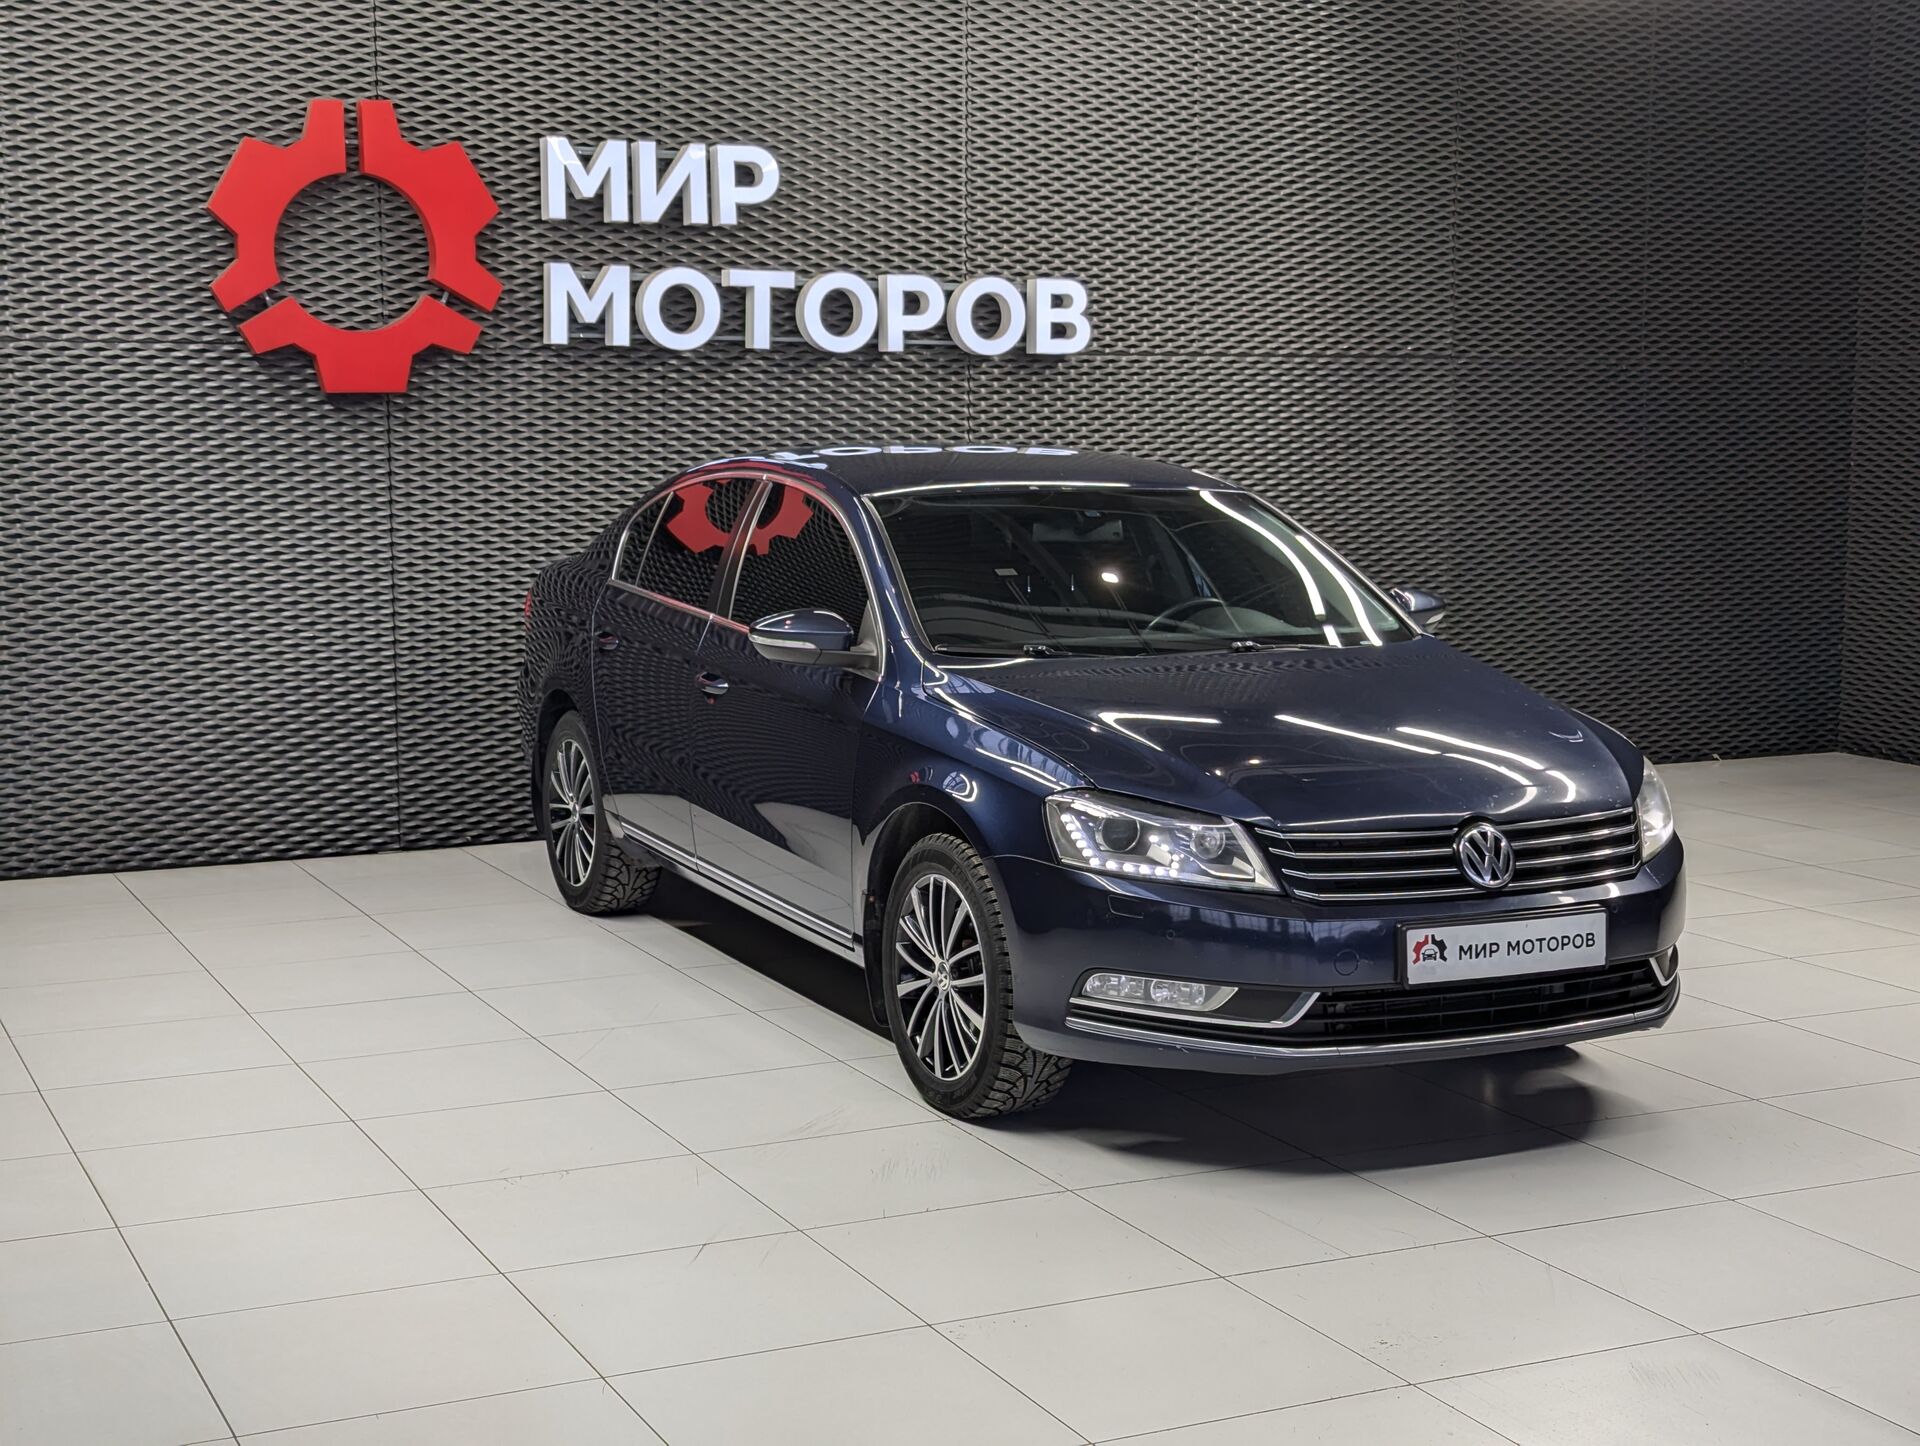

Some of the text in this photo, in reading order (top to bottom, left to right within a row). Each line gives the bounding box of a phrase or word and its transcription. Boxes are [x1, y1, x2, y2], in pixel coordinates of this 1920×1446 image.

[540, 135, 780, 226] МИР
[543, 262, 1092, 355] МОТОРОВ
[1458, 932, 1596, 961] МИР МОТОРОВ
